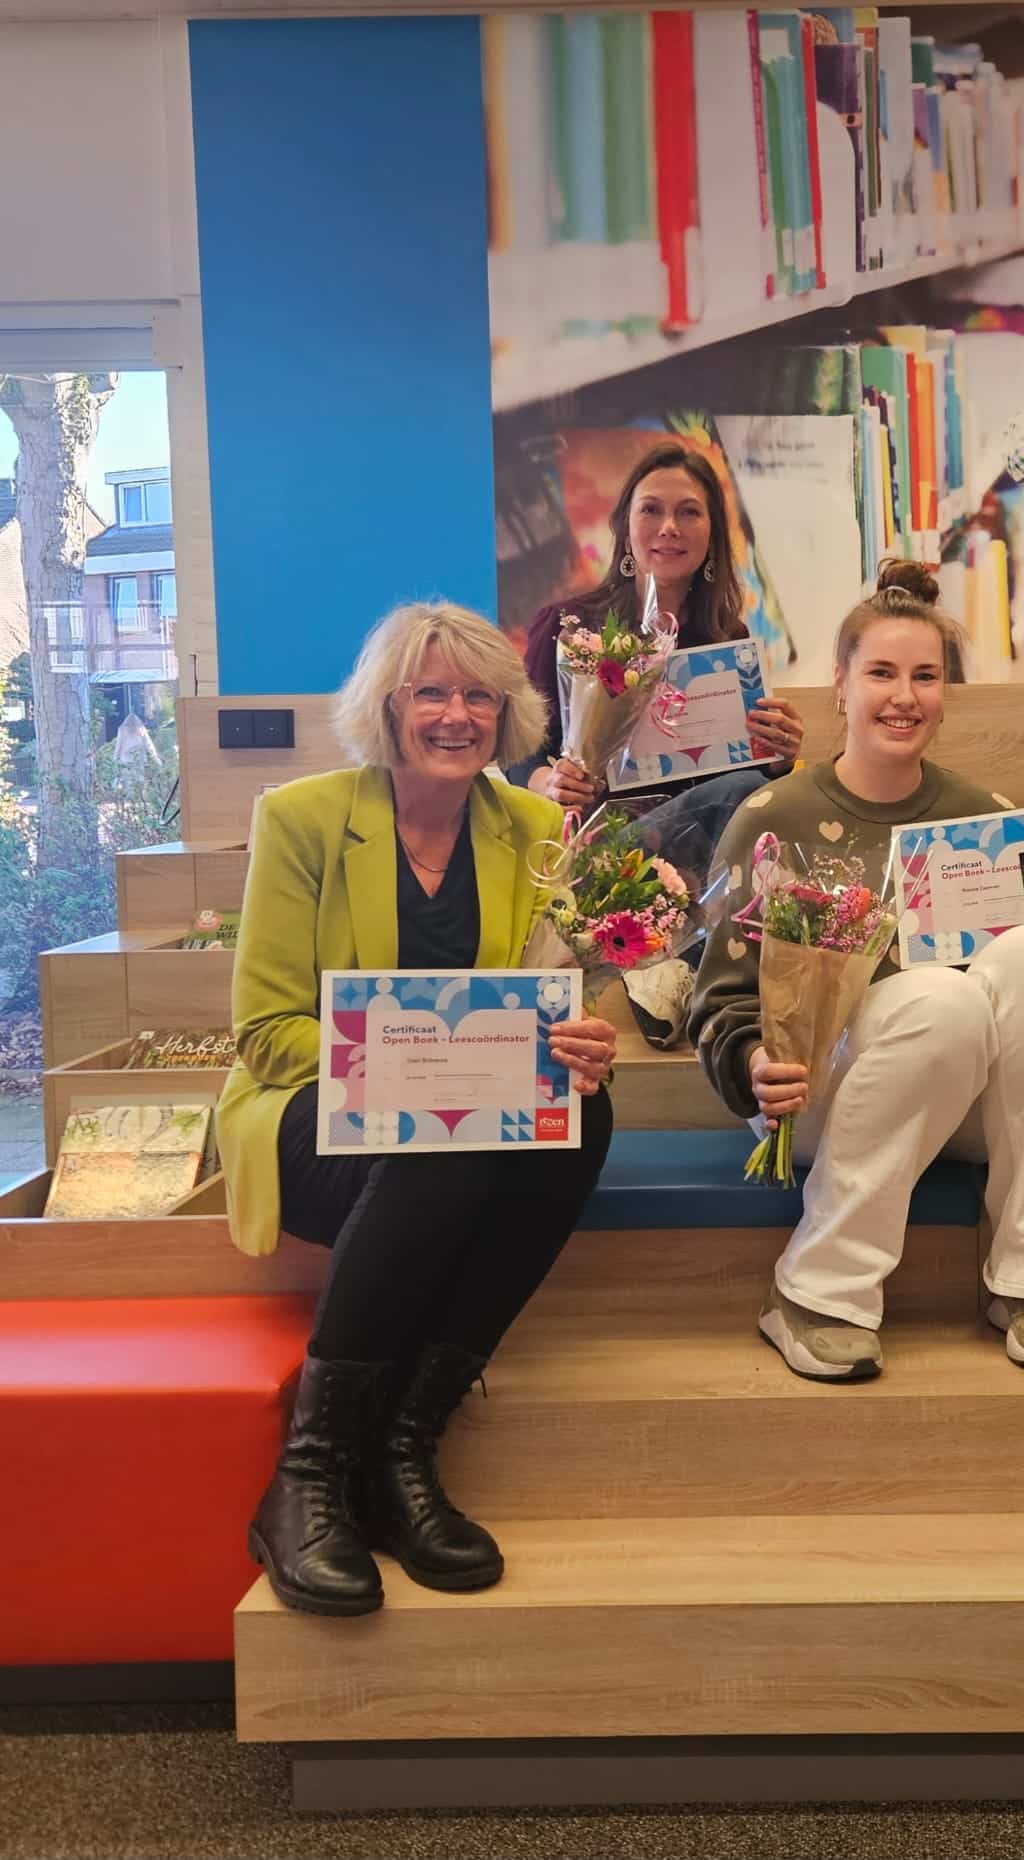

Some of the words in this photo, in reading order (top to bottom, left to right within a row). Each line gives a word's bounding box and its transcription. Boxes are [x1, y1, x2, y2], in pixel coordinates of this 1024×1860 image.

[941, 861, 982, 871] Certificaat
[942, 870, 963, 880] Open
[383, 1025, 437, 1033] Certificaat
[383, 1035, 411, 1045] Open
[414, 1035, 438, 1044] Boek
[449, 1034, 529, 1043] Leescoördinator
[156, 1035, 237, 1056] Herfst
